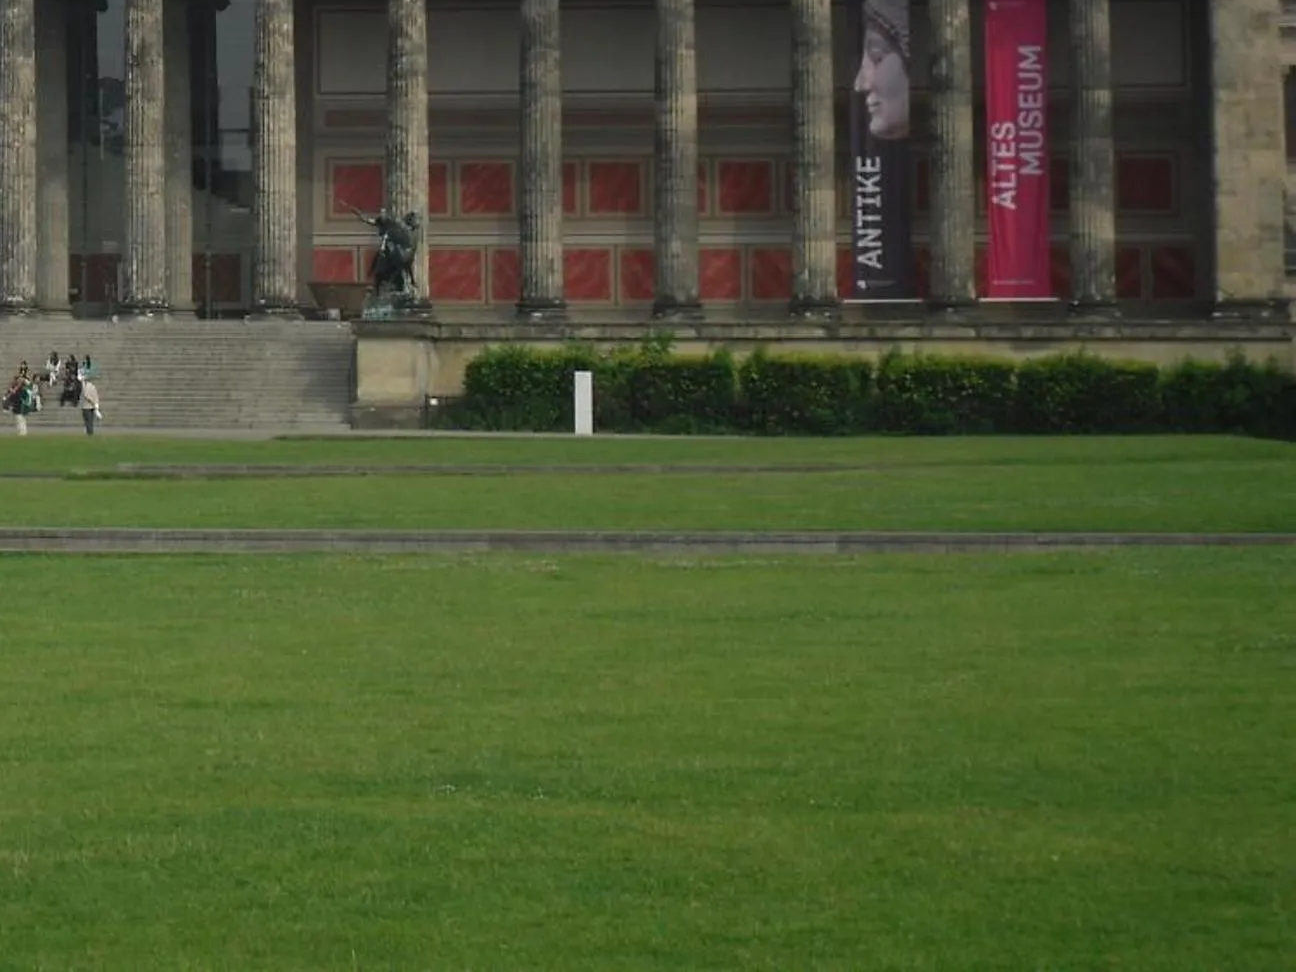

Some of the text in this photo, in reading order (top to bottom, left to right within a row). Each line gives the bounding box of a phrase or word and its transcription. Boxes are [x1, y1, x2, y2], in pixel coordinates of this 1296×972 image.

[992, 121, 1017, 210] ALTES
[1017, 45, 1044, 175] MUSEUM
[856, 156, 883, 269] ANTIKE
